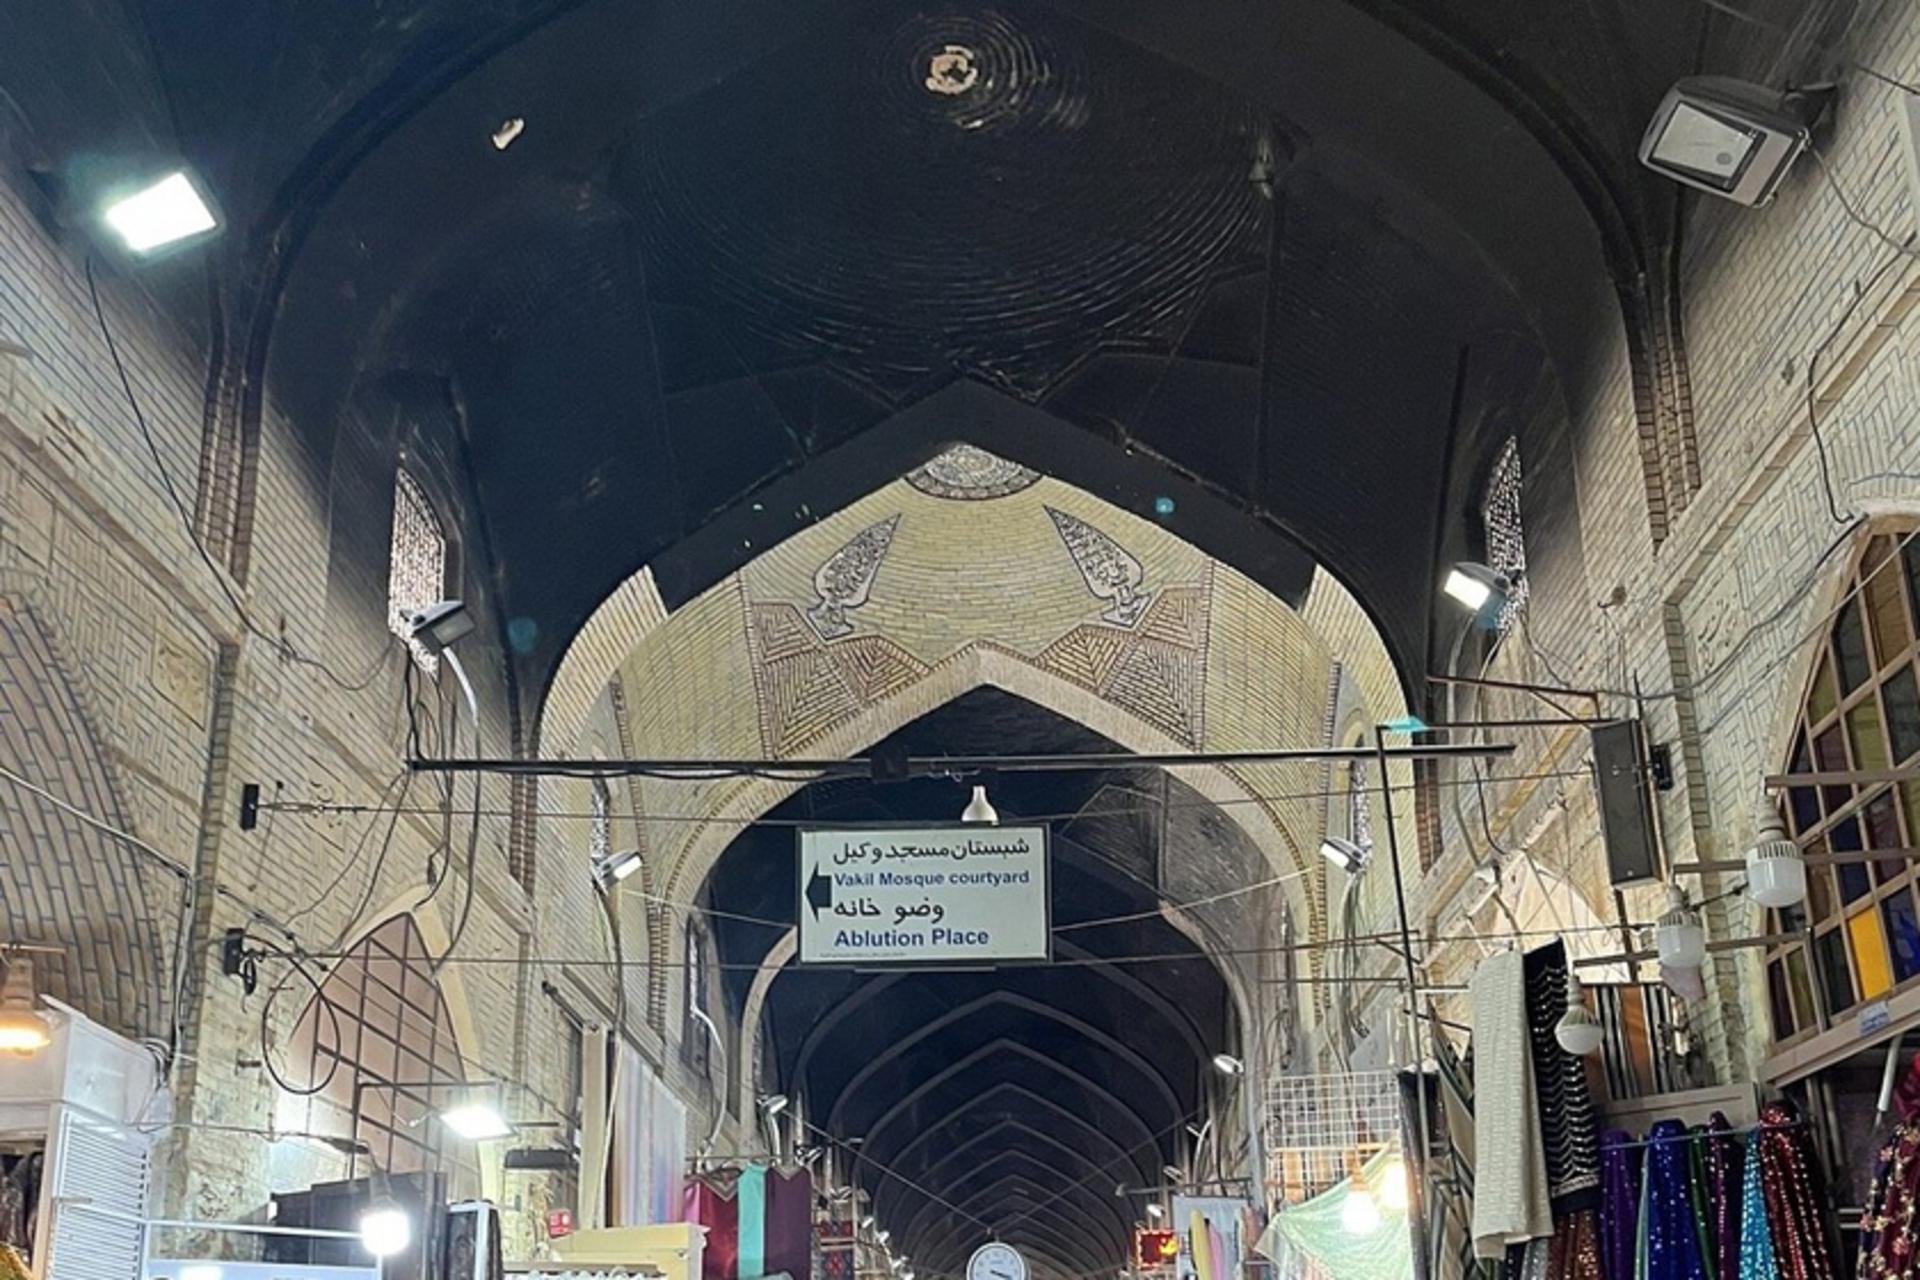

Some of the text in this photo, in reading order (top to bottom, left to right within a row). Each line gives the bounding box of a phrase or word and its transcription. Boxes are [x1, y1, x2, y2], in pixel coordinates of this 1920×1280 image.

[949, 837, 1030, 860] شبستان
[834, 870, 1030, 888] Vakil Mosque courtyard
[834, 896, 945, 925] وضو خانه
[834, 928, 989, 948] Ablution Place
